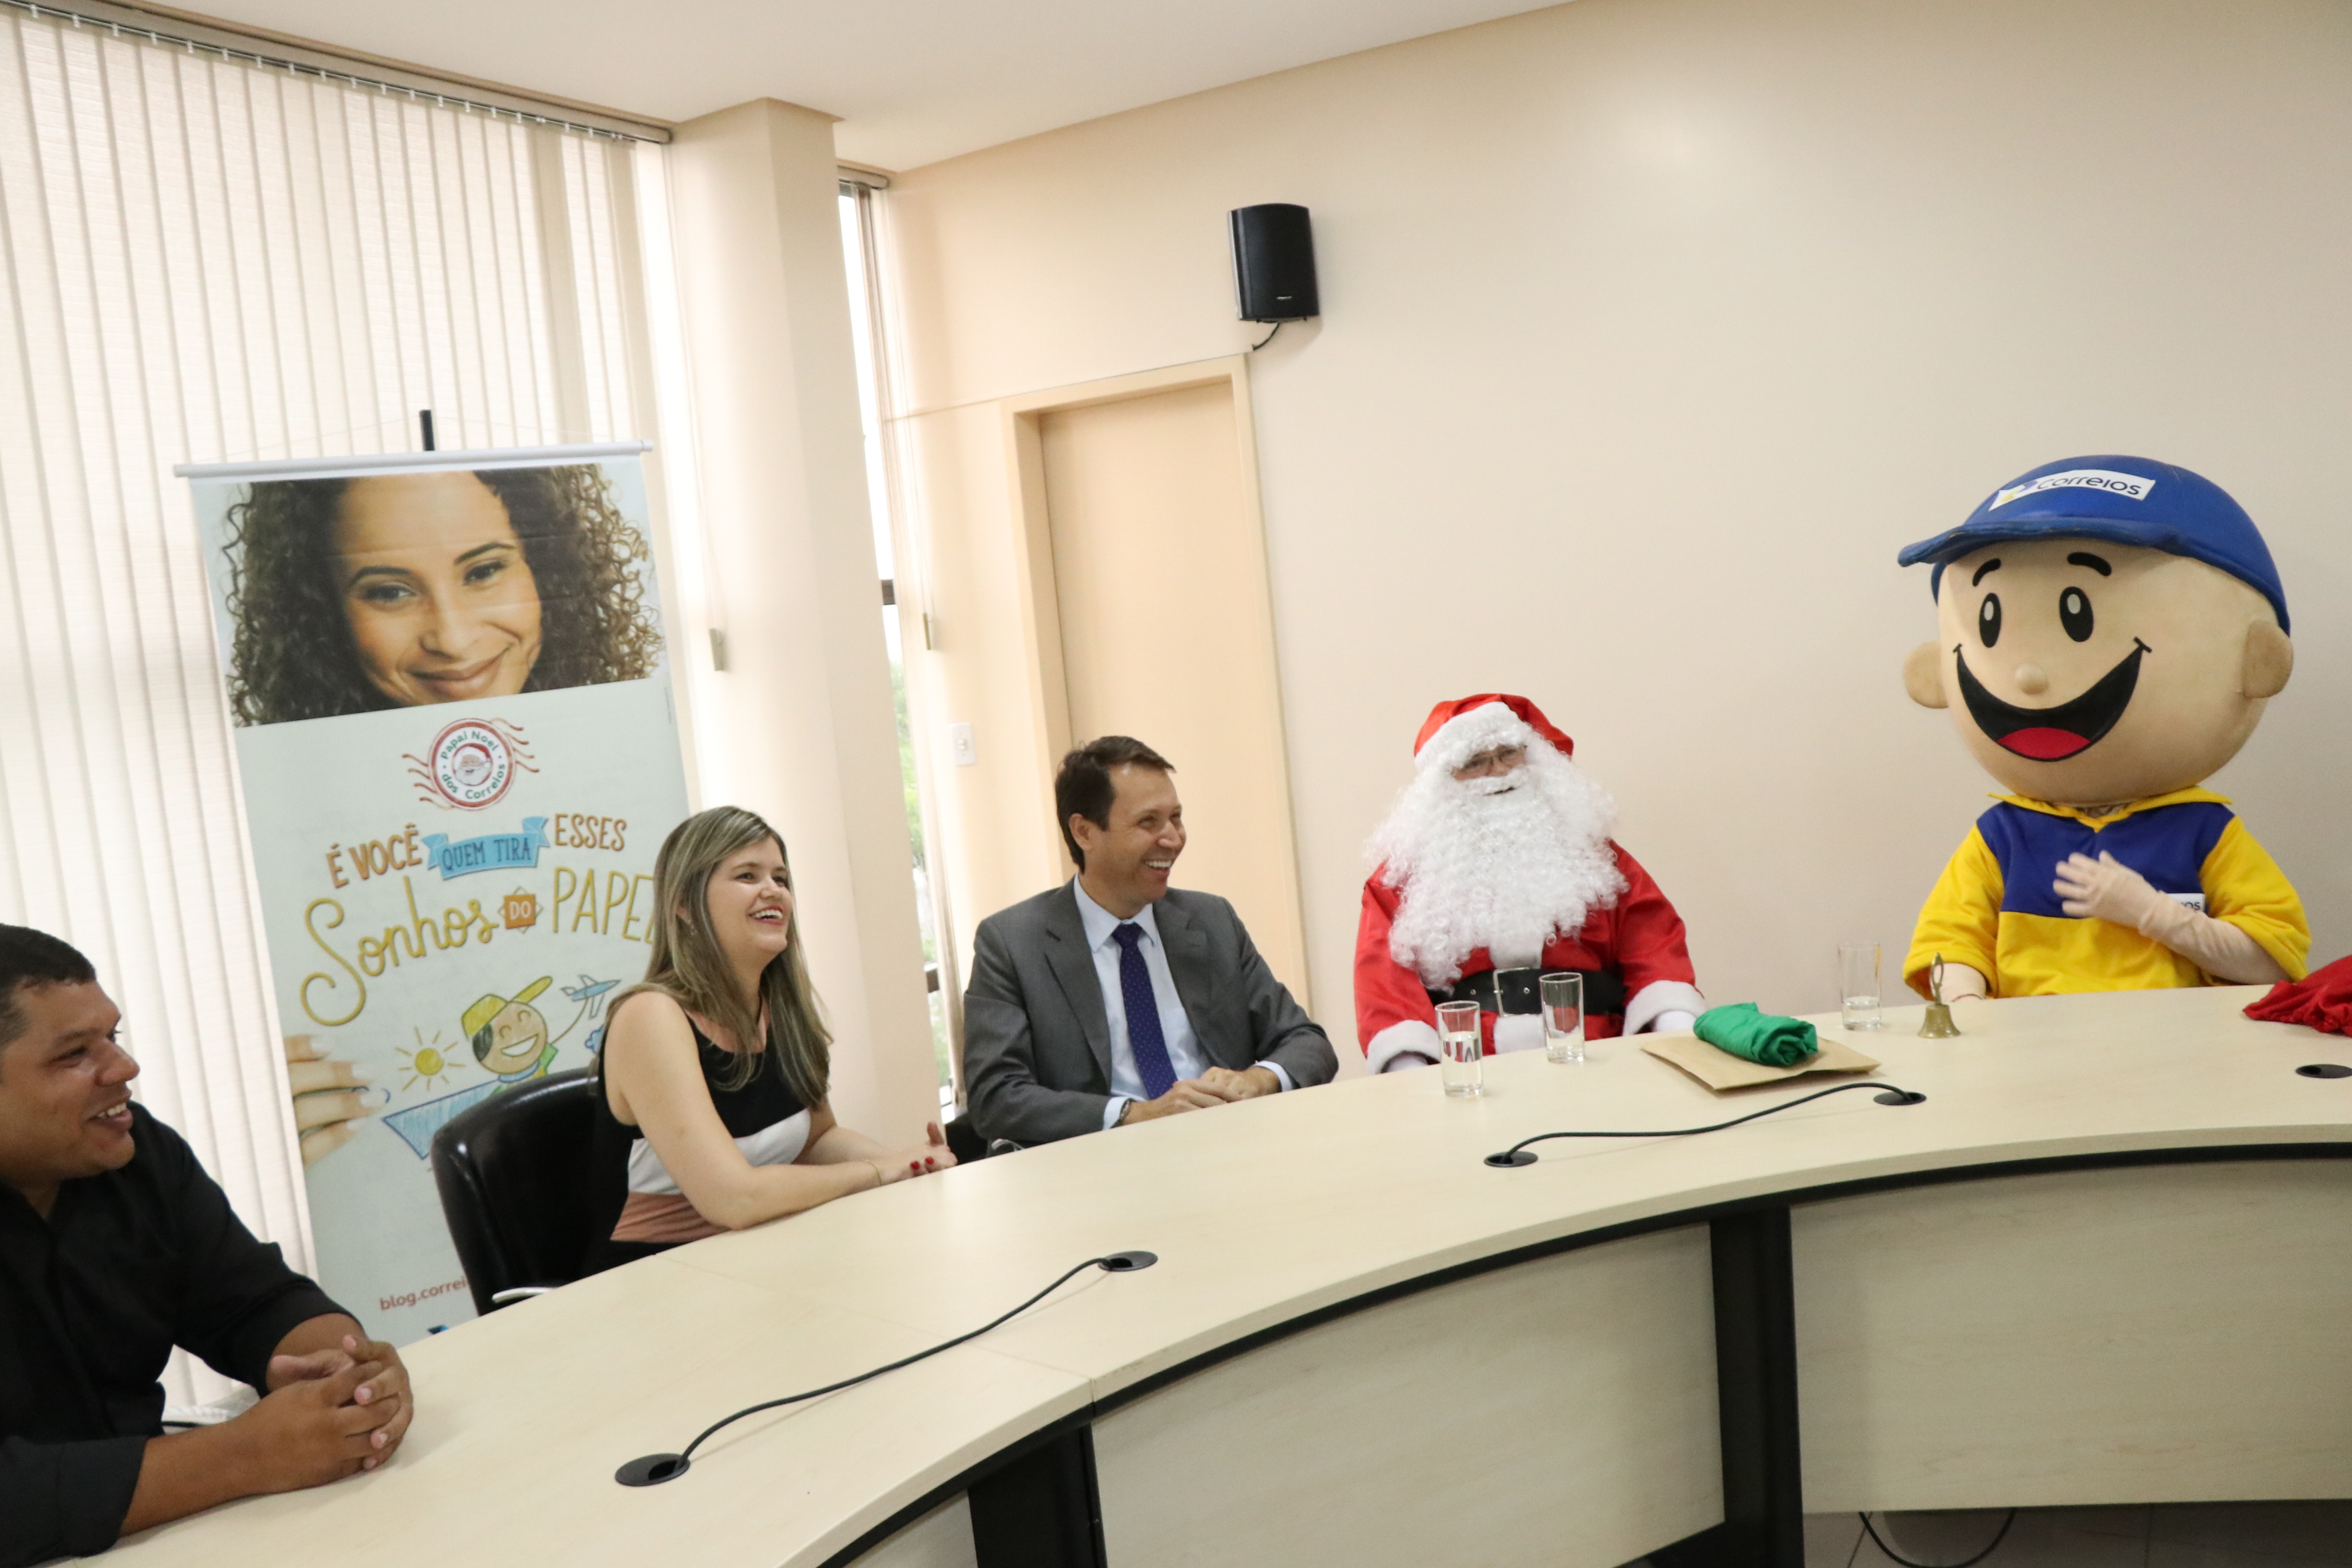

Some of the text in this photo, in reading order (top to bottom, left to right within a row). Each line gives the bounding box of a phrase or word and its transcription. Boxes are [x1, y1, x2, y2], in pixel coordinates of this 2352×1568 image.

[440, 730, 499, 760] Papai Noel
[442, 763, 505, 799] dos Correios
[326, 813, 628, 889] É VOCÊ QUEM TIRA ESSES
[300, 875, 499, 1027] Sonhos
[509, 900, 533, 920] DO
[379, 1274, 469, 1311] blog.correi
